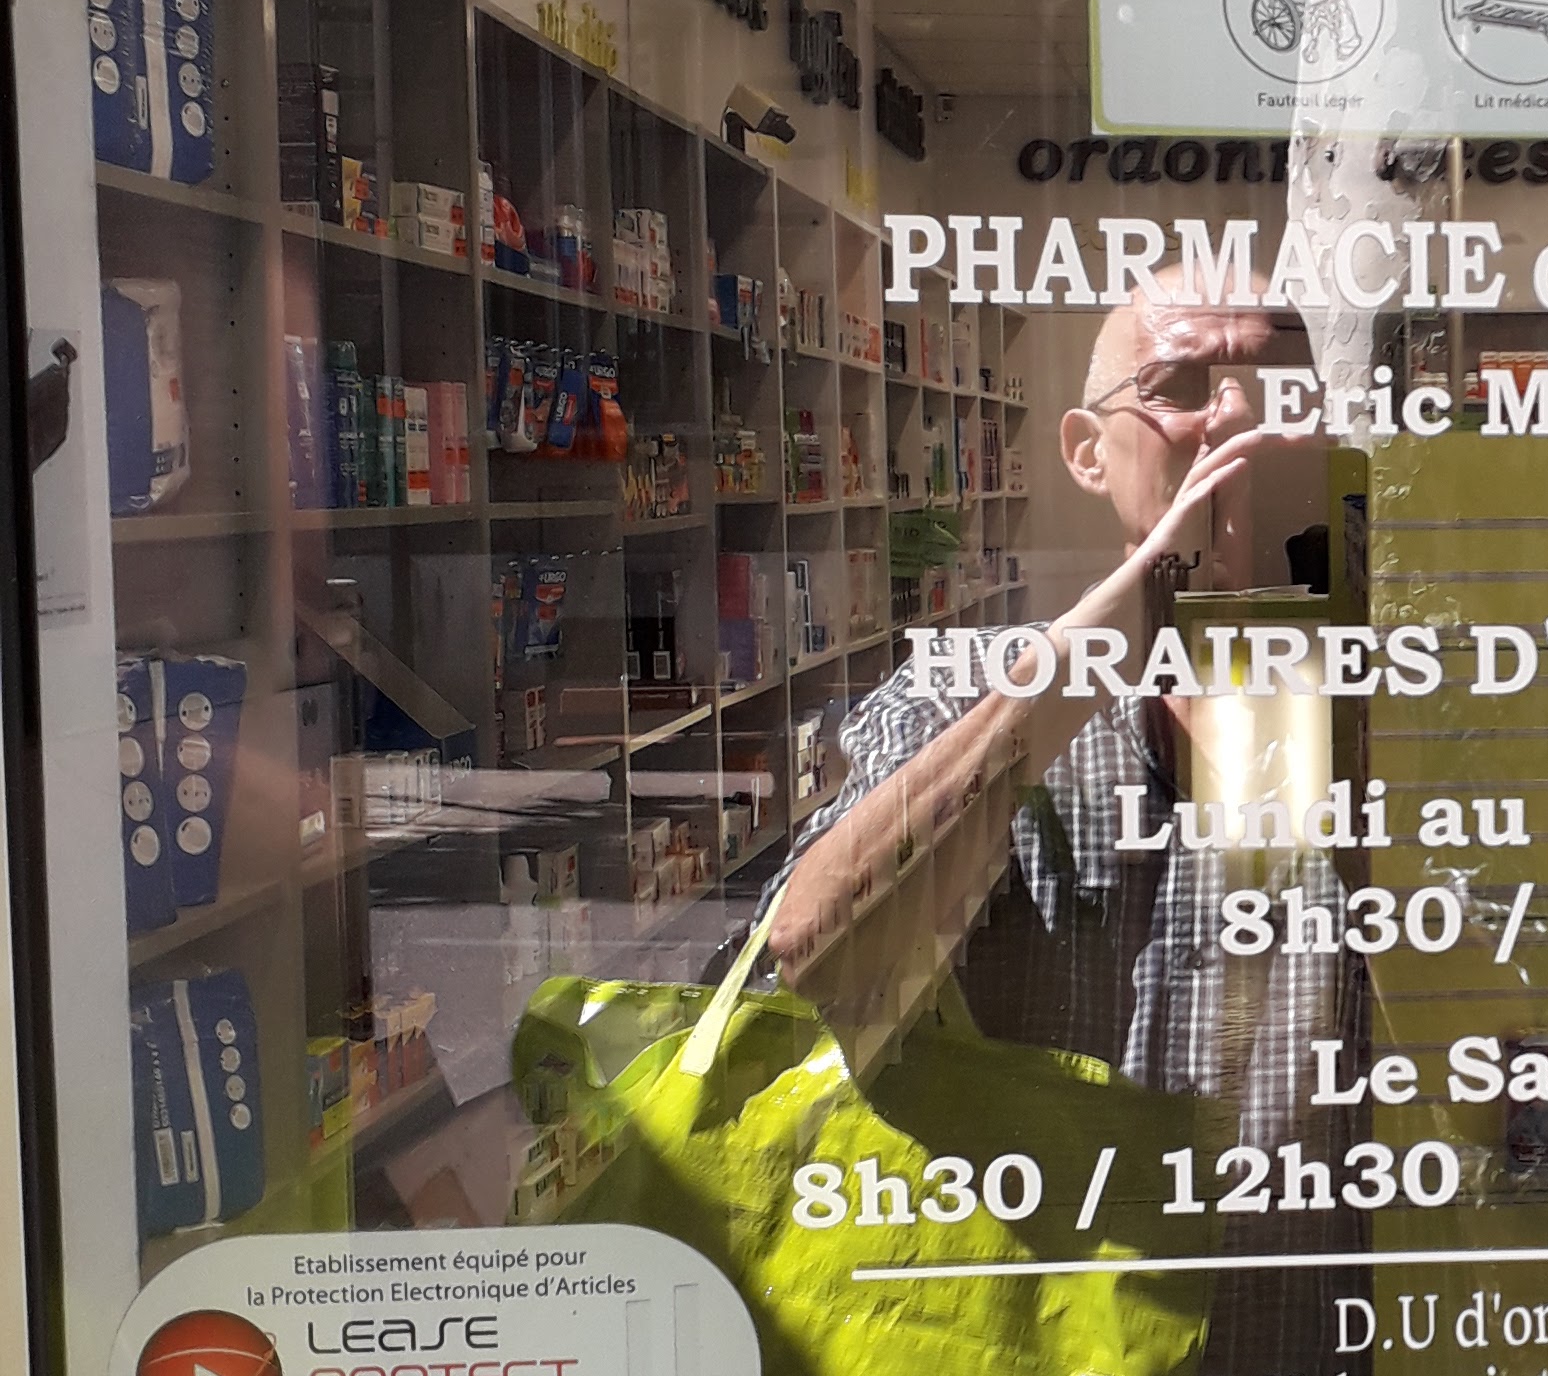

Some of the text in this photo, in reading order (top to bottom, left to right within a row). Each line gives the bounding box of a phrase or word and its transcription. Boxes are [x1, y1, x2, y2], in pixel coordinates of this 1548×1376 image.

[1474, 92, 1496, 110] Lit
[884, 213, 1506, 310] PHARMACIE
[1256, 364, 1453, 437] Eric
[902, 623, 1444, 701] HORAIRES
[1111, 780, 1391, 854] Lundi
[1417, 796, 1529, 851] au
[1218, 885, 1466, 958] 8h30
[1492, 882, 1535, 966] /
[1308, 1036, 1420, 1109] Le
[791, 1155, 1044, 1232] 8h30
[1075, 1147, 1117, 1232] /
[1159, 1141, 1462, 1217] 12h30
[246, 1286, 264, 1307] la
[270, 1282, 385, 1307] Protection
[389, 1278, 529, 1308] Electronique
[293, 1247, 587, 1277] Etablissement équipé pour
[1333, 1298, 1440, 1358] D.U
